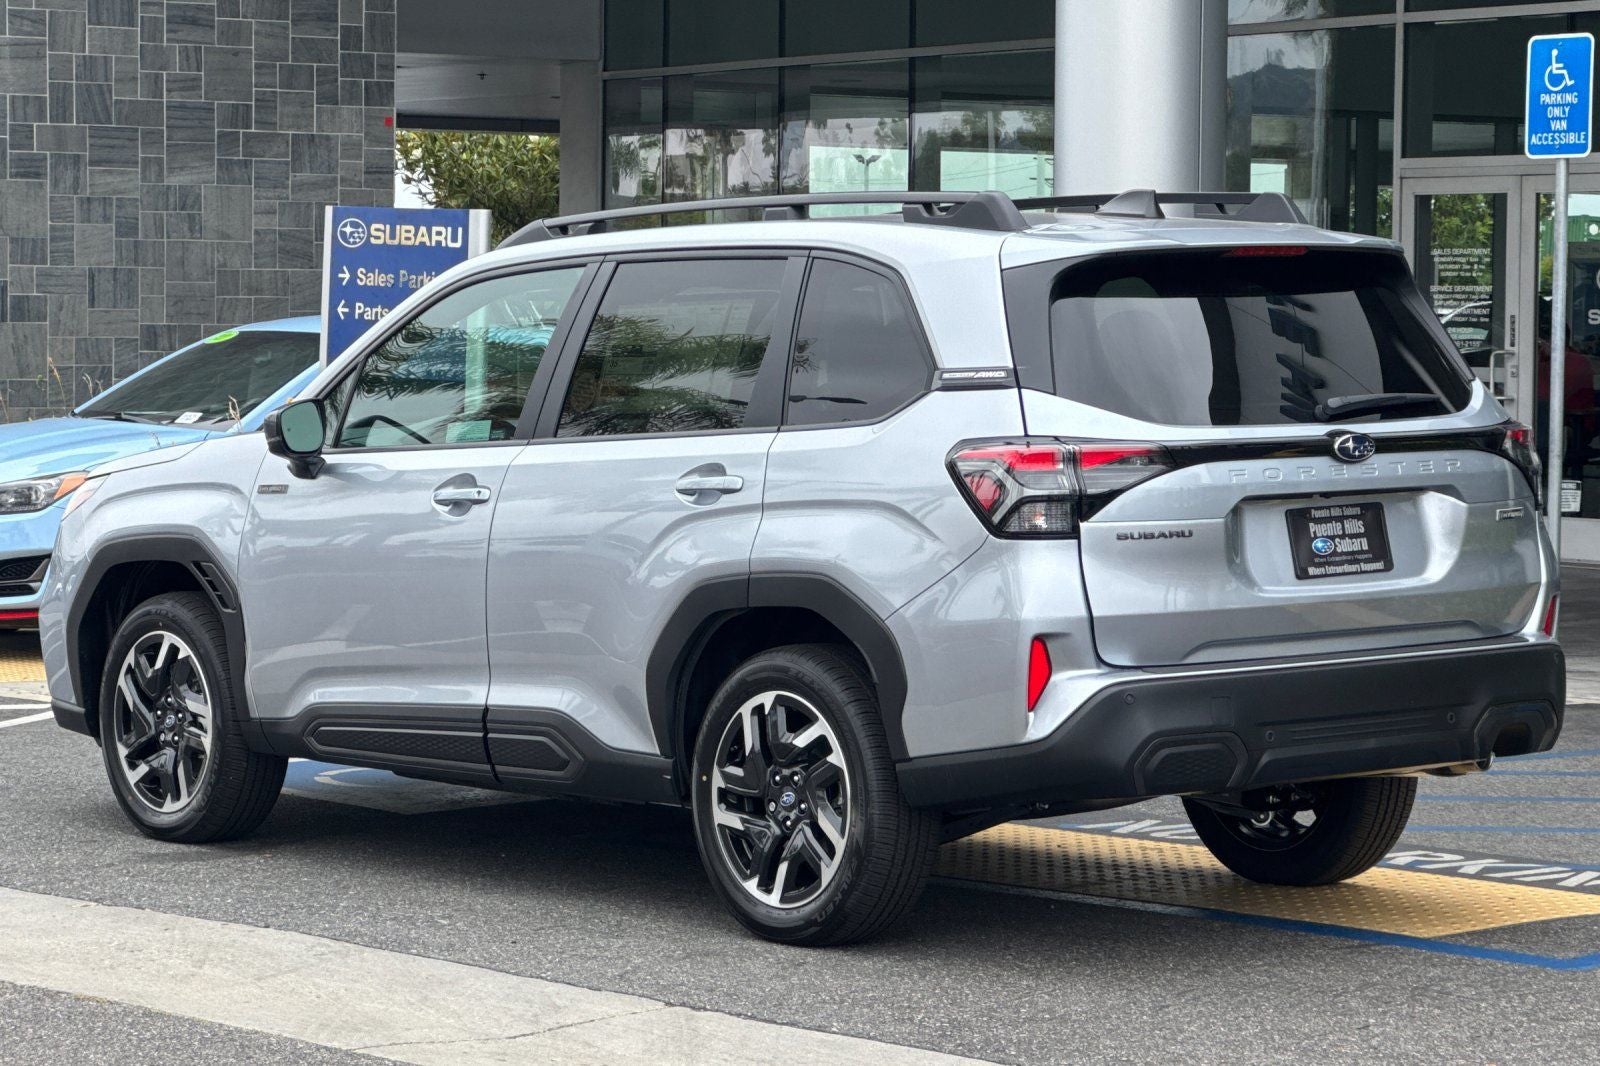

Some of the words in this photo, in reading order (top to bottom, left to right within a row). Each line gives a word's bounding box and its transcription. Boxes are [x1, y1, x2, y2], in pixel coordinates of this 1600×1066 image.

[1540, 92, 1578, 104] PARKING
[1547, 106, 1570, 118] ONLY
[1550, 119, 1567, 131] VAN
[1531, 131, 1586, 145] ACCESSIBLE
[370, 223, 463, 248] SUBARU
[357, 267, 394, 287] Sales
[399, 269, 436, 288] Park
[354, 302, 389, 321] Parts
[1228, 459, 1463, 484] FORESTER
[1311, 507, 1330, 518] Puente
[1330, 507, 1342, 517] Hills
[1343, 505, 1361, 516] Subaru
[1309, 520, 1343, 537] Puente
[1344, 518, 1365, 534] Hills
[1116, 529, 1194, 541] SUBARU
[1335, 537, 1369, 553] Subaru
[1307, 566, 1326, 576] Where
[1326, 563, 1361, 575] Extraordinary
